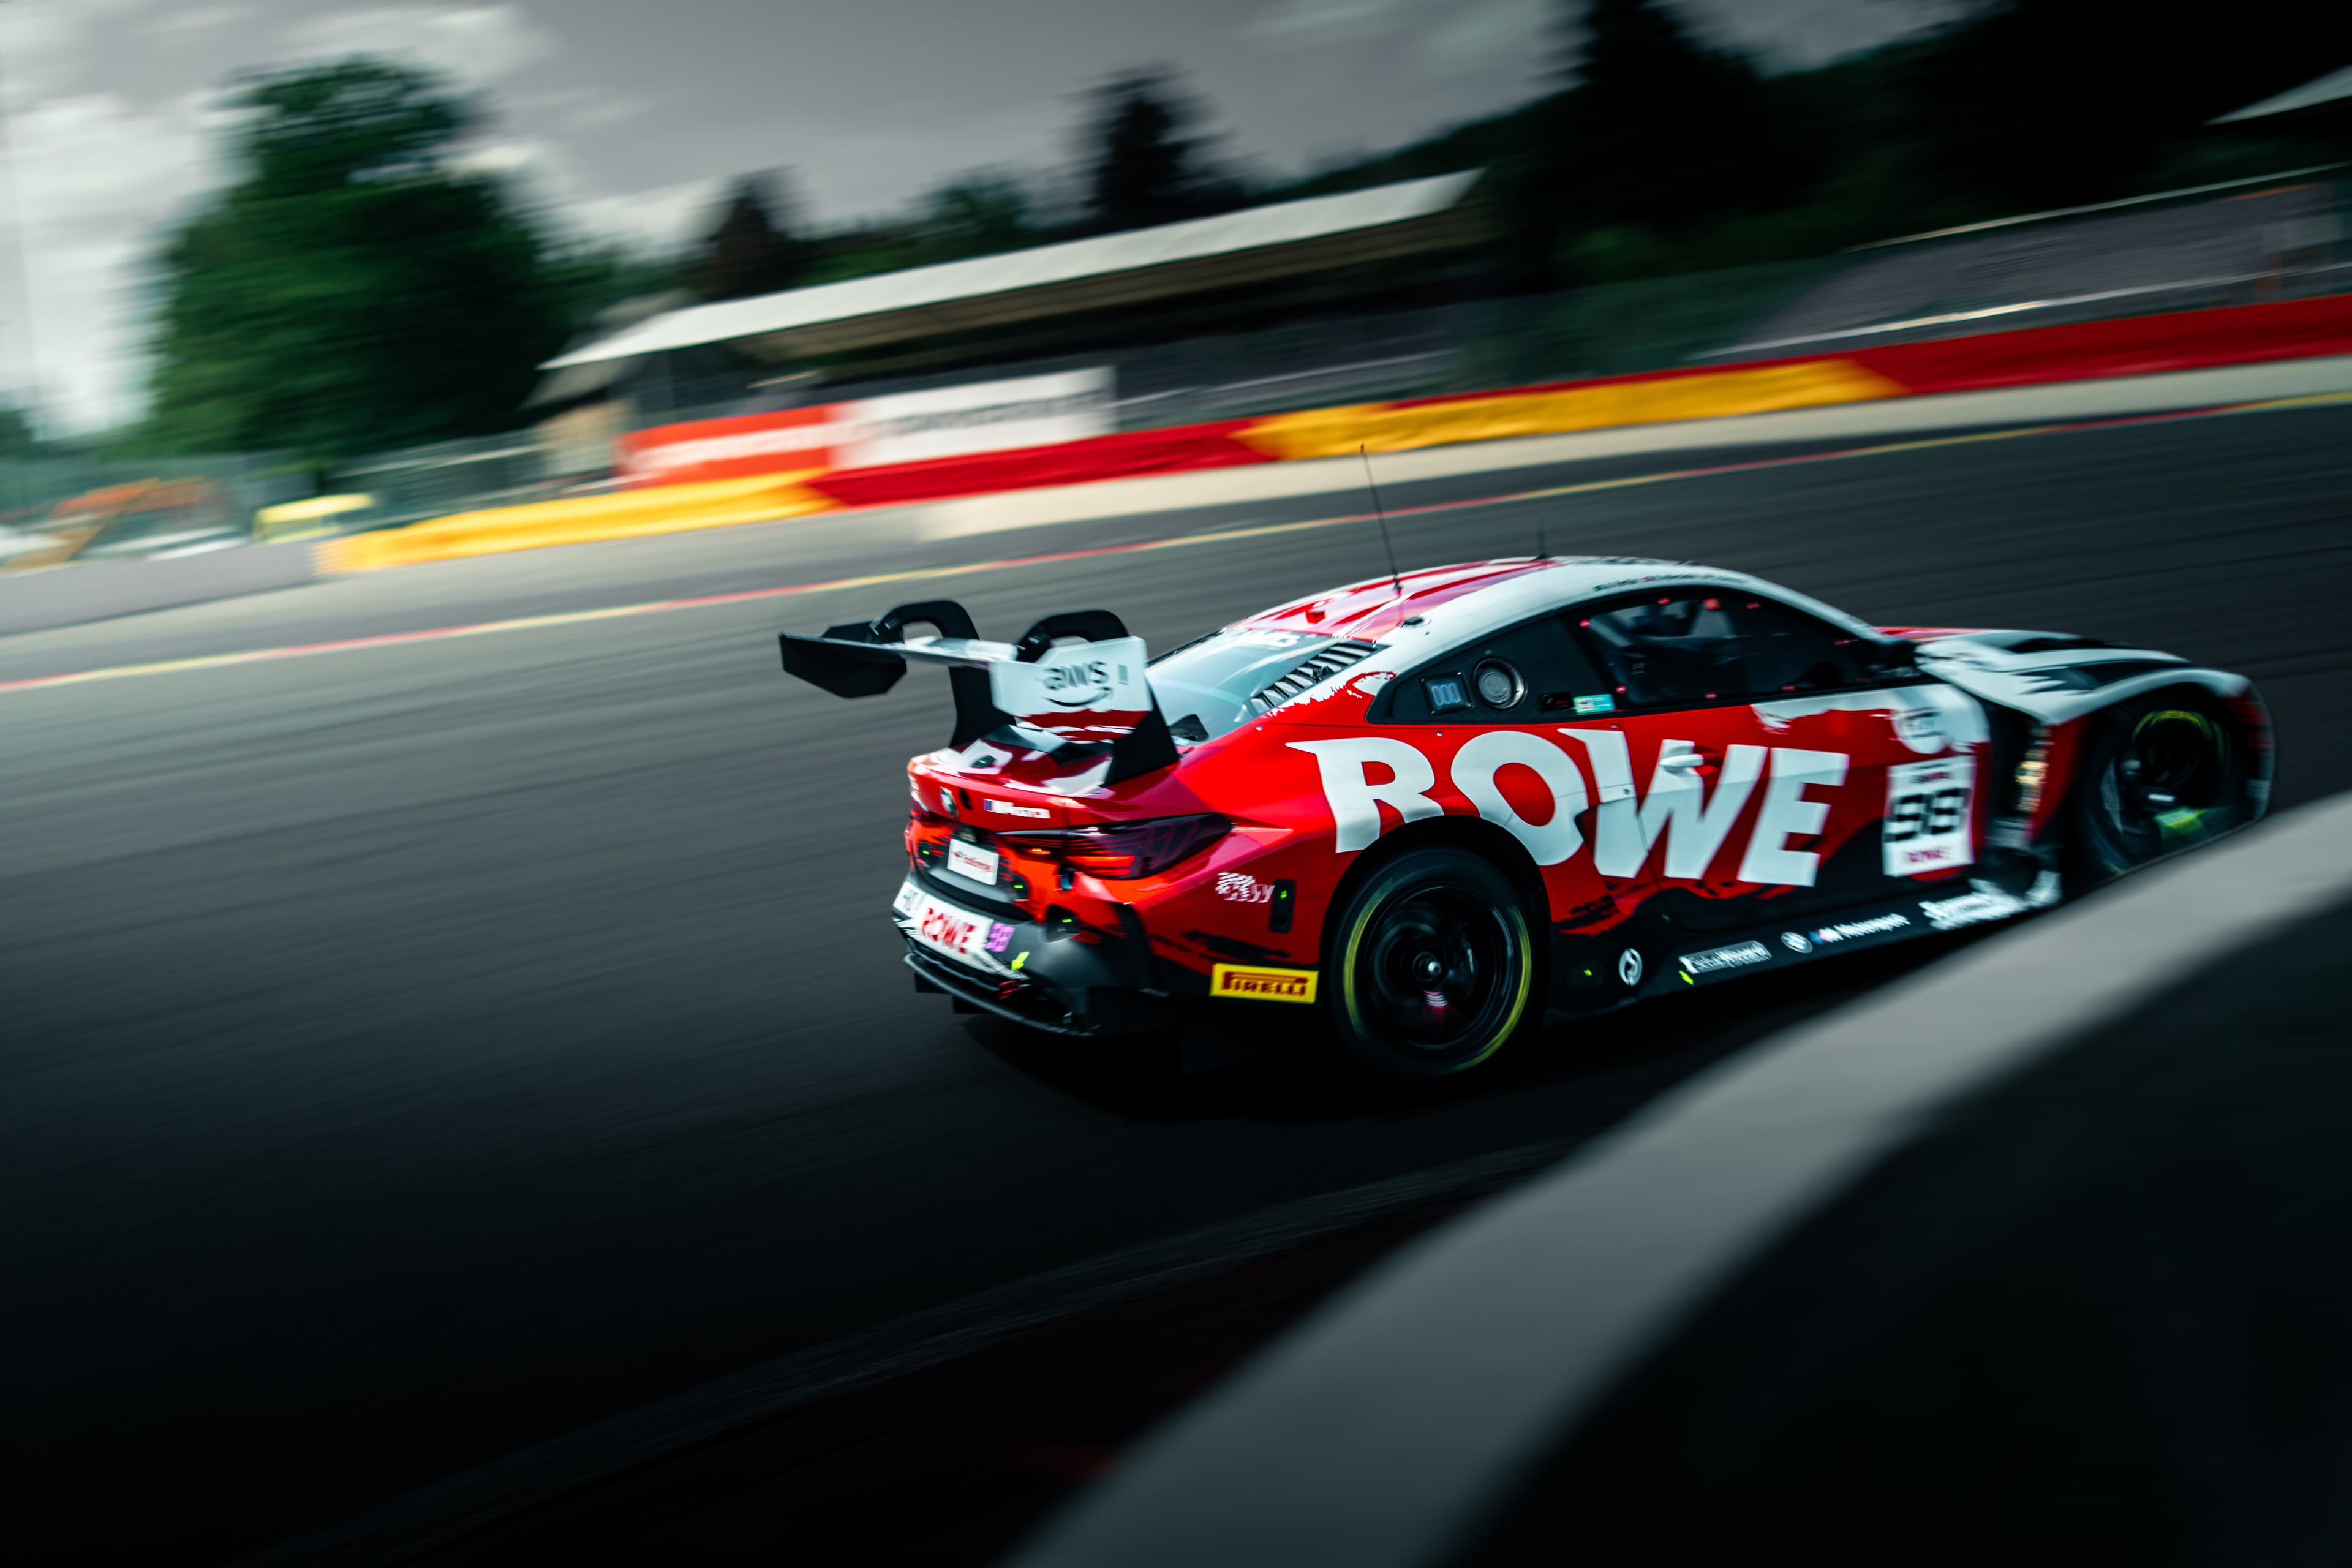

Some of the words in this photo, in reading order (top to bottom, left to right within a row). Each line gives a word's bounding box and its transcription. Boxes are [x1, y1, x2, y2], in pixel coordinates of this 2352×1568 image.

[1043, 660, 1109, 691] aws
[1284, 729, 1849, 886] ROWE
[1883, 788, 1970, 843] 98
[921, 907, 976, 954] ROWE
[1220, 970, 1310, 997] PIRELLI
